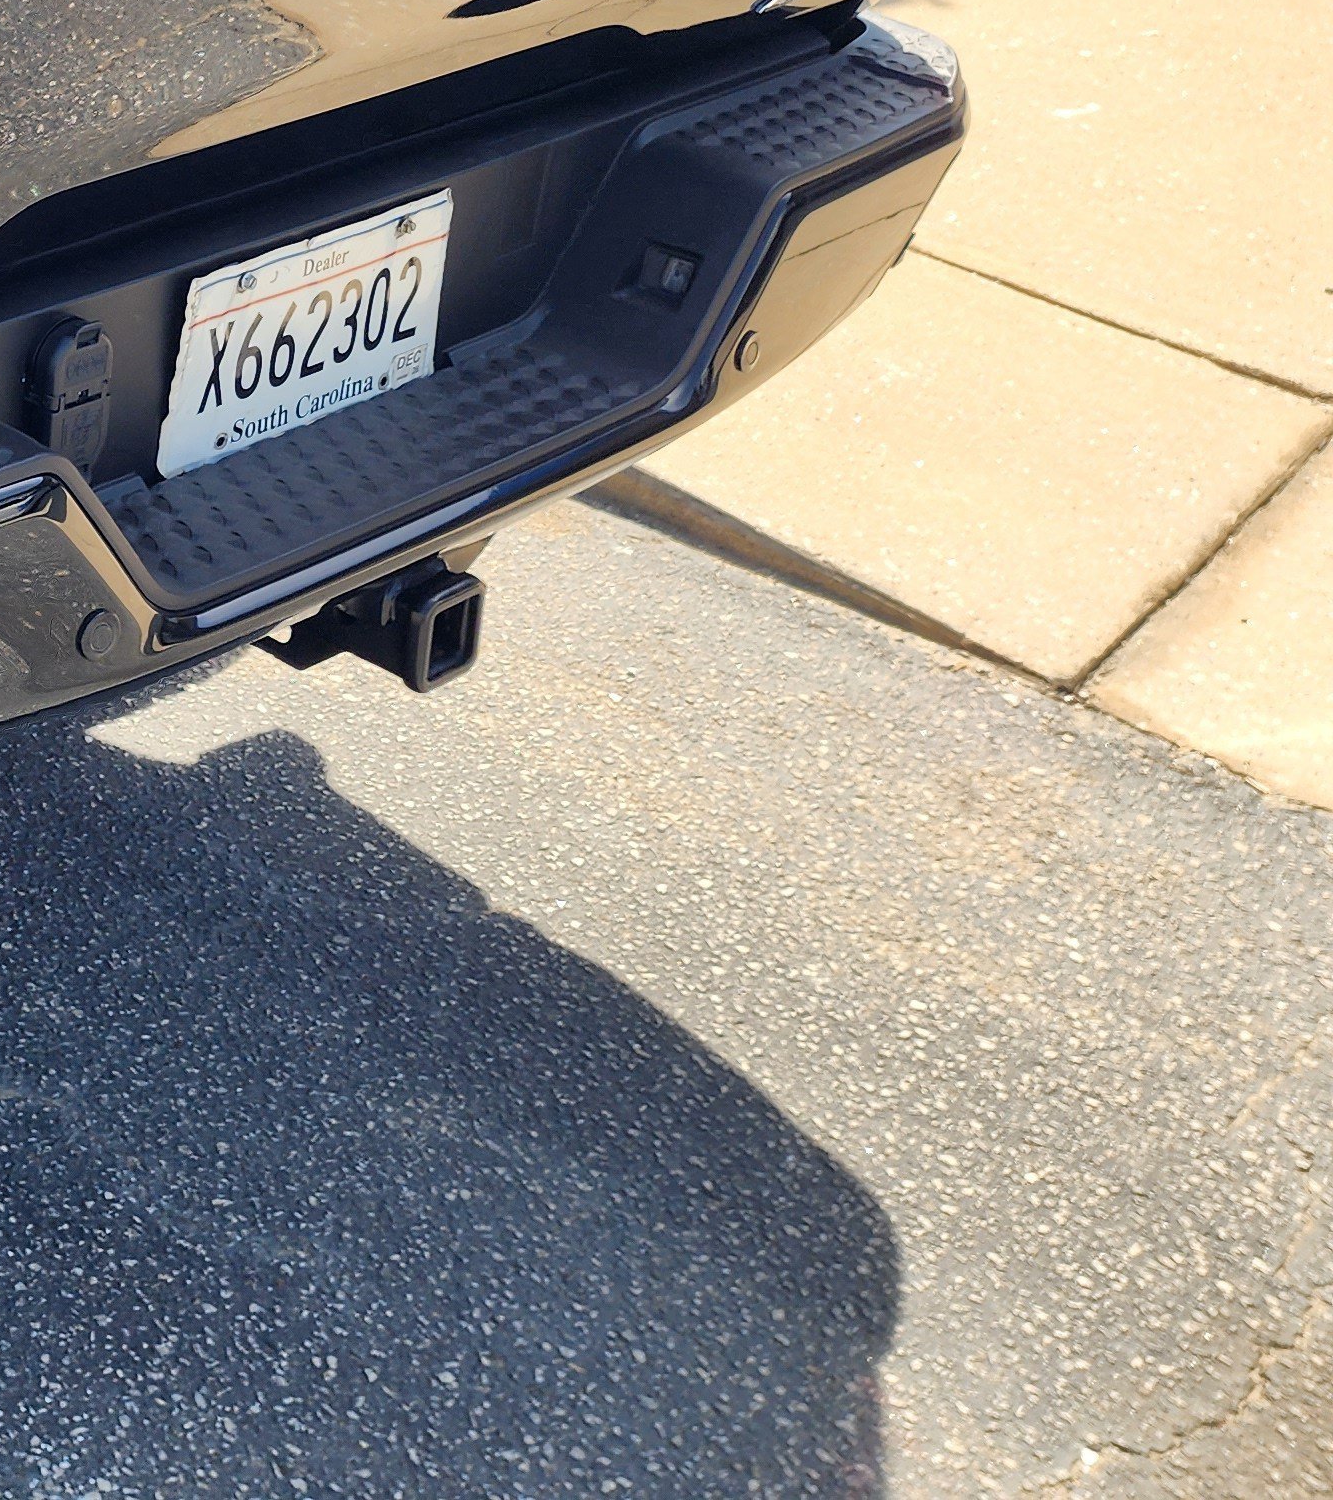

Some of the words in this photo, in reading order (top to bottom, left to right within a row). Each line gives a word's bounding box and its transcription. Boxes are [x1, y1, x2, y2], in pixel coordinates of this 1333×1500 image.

[302, 250, 350, 277] Dealer
[197, 256, 423, 415] X662302
[396, 349, 422, 370] DEC
[230, 404, 288, 444] South
[294, 375, 374, 419] Carolina
